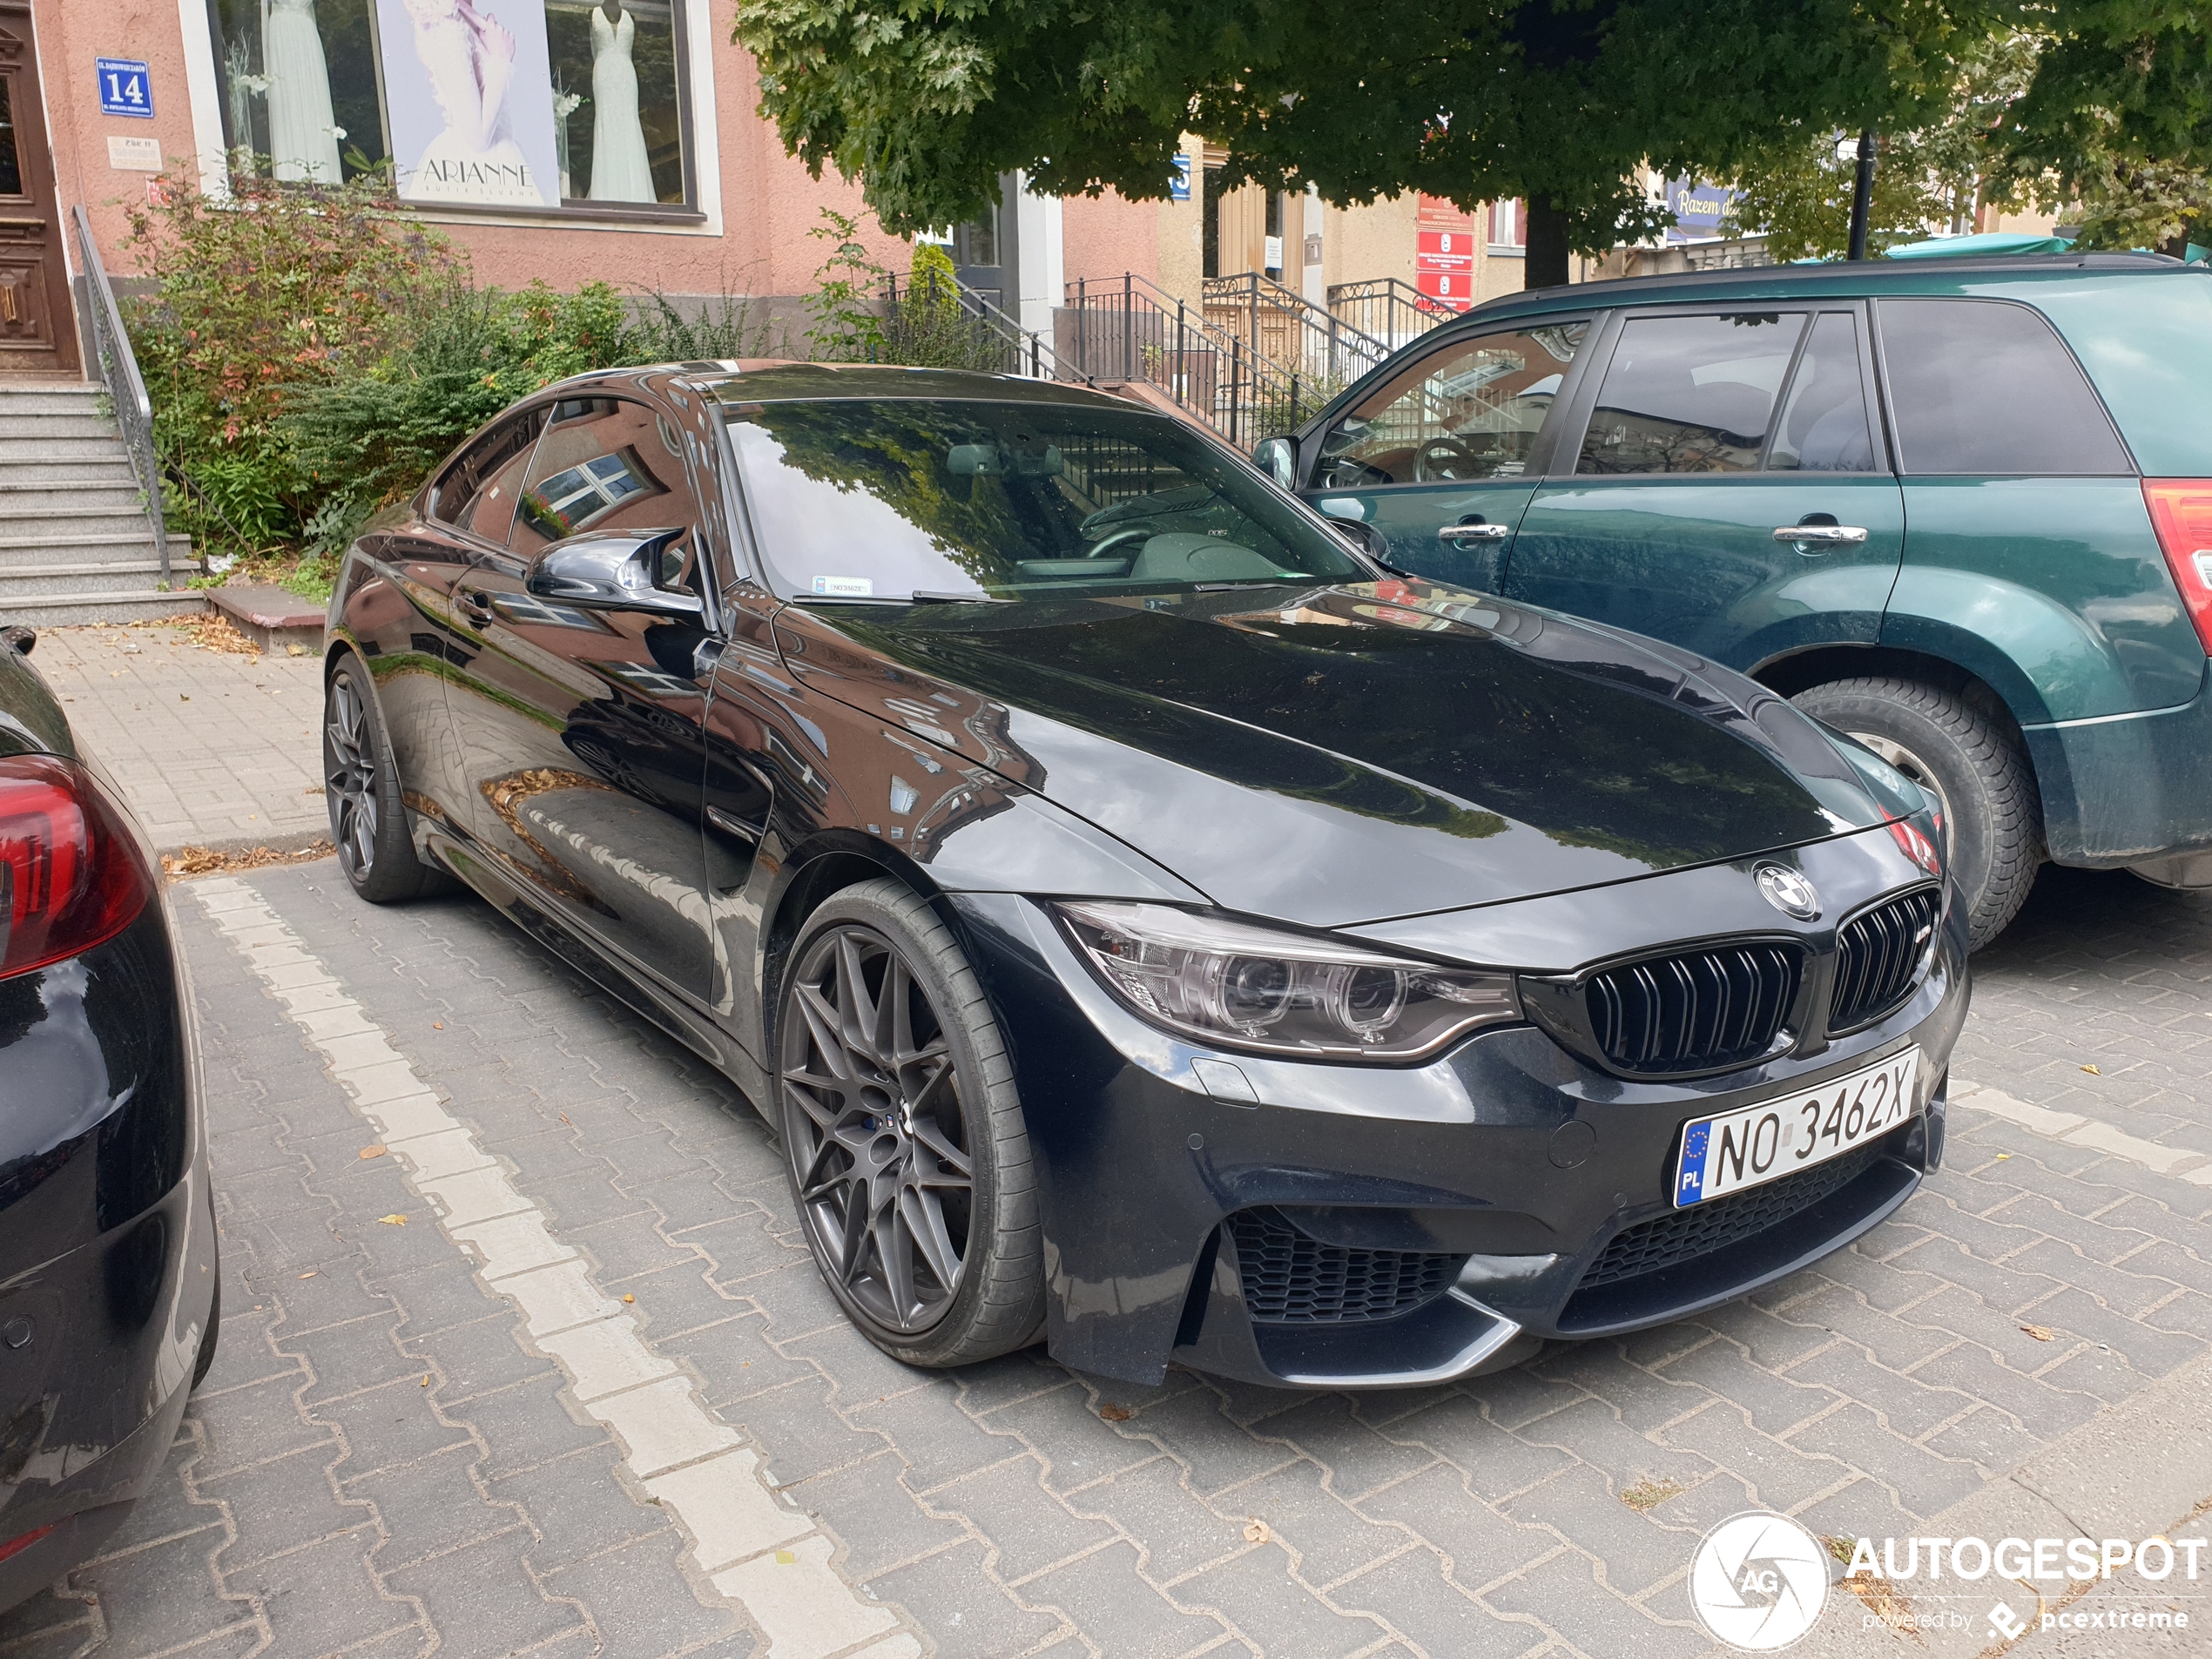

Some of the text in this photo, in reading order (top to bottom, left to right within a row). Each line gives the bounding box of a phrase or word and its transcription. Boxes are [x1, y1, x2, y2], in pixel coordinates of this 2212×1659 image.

[107, 73, 144, 105] 14
[423, 158, 534, 187] ARIANNE
[1677, 188, 1720, 216] Razem
[1715, 1060, 1911, 1188] NO 3462X
[1682, 1172, 1700, 1190] PL
